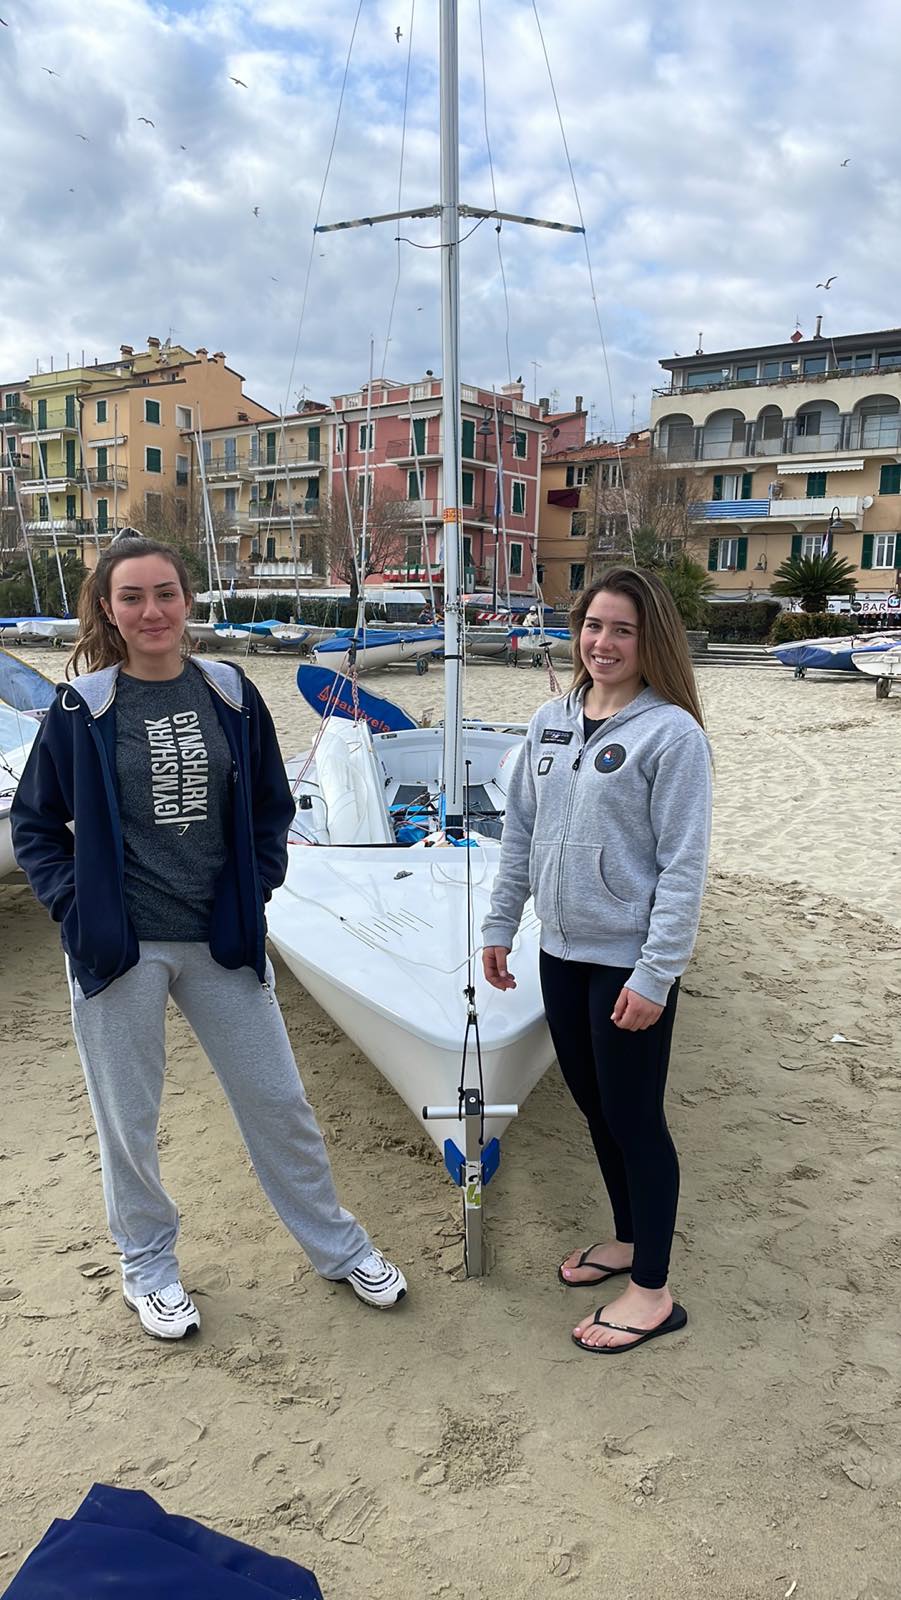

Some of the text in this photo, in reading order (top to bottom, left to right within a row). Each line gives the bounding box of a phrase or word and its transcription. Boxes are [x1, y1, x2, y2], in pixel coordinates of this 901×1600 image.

[862, 603, 887, 612] BAR
[144, 716, 180, 817] GYMSHARK
[172, 710, 209, 814] GYMSHARK
